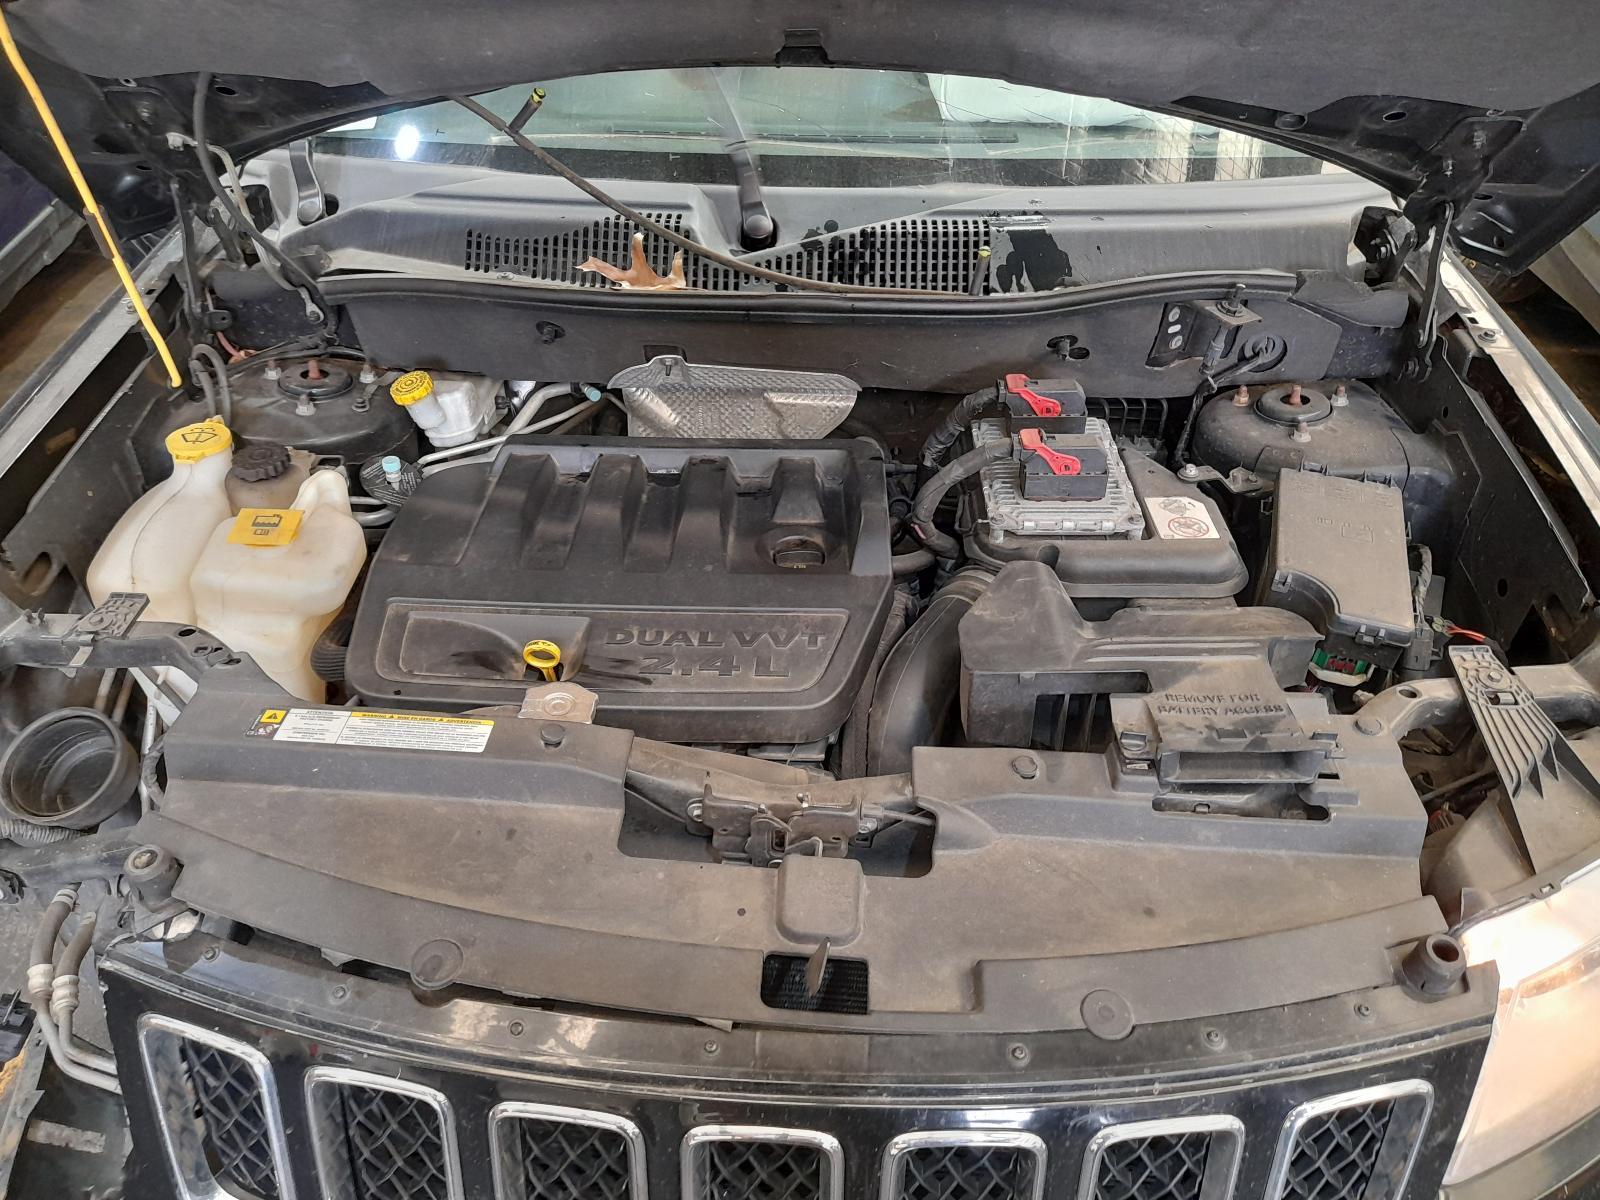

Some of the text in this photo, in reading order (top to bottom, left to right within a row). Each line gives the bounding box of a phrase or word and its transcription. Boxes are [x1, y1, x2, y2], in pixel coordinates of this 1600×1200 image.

[605, 629, 826, 649] DUAL VVT
[1164, 693, 1261, 703] REMOVE FOR
[1157, 704, 1284, 716] BATTERY ACCESS
